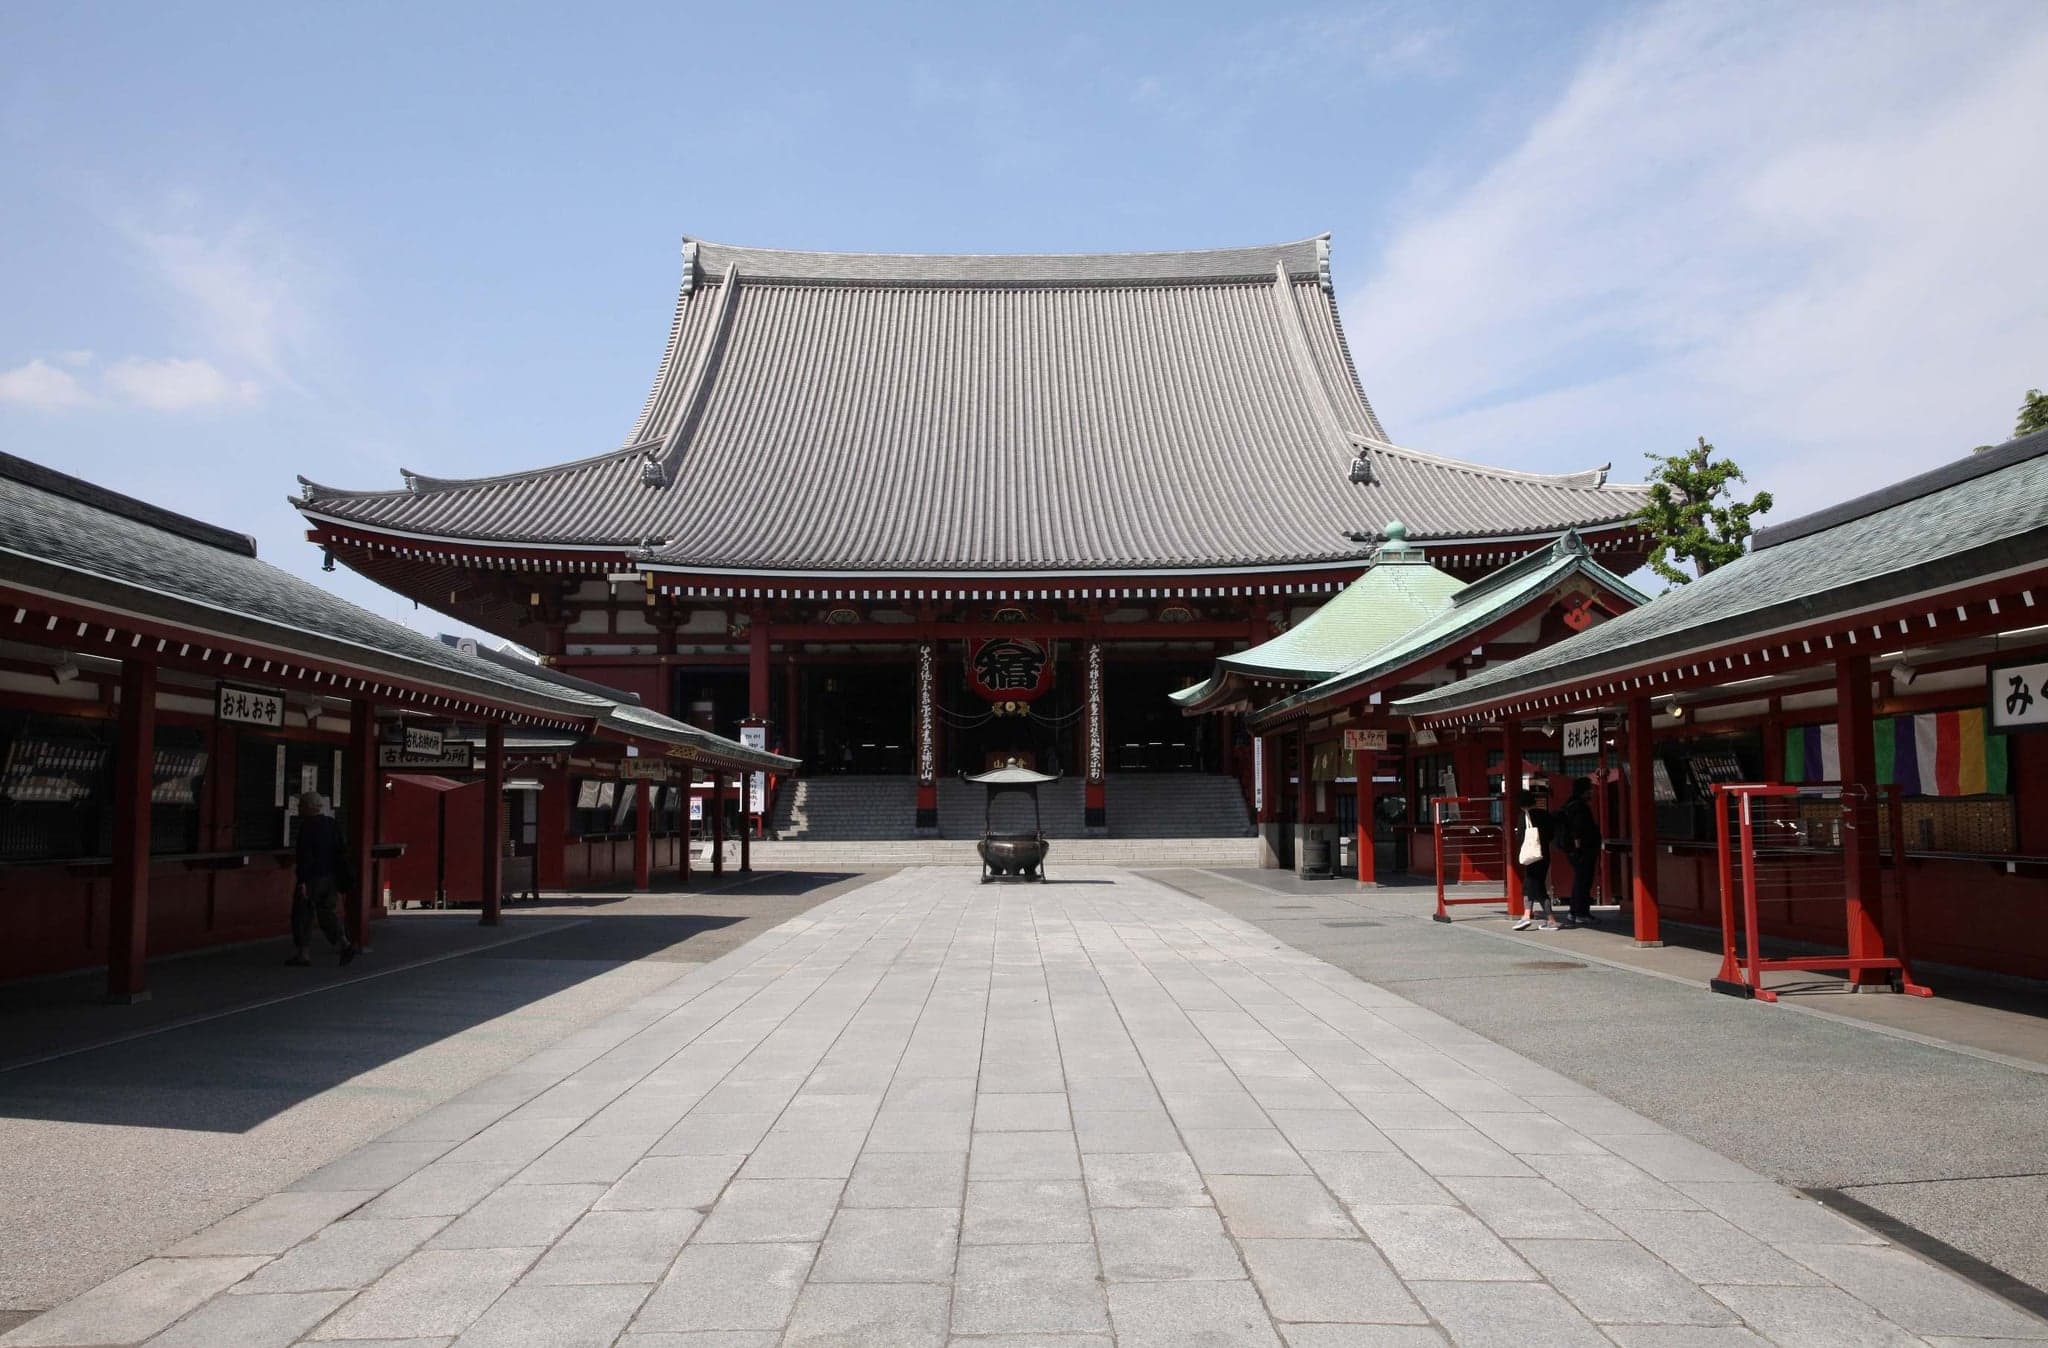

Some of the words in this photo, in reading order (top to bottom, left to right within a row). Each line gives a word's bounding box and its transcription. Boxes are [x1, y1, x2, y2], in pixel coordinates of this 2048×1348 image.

[223, 692, 277, 723] お札お守
[1568, 725, 1598, 749] お札お守
